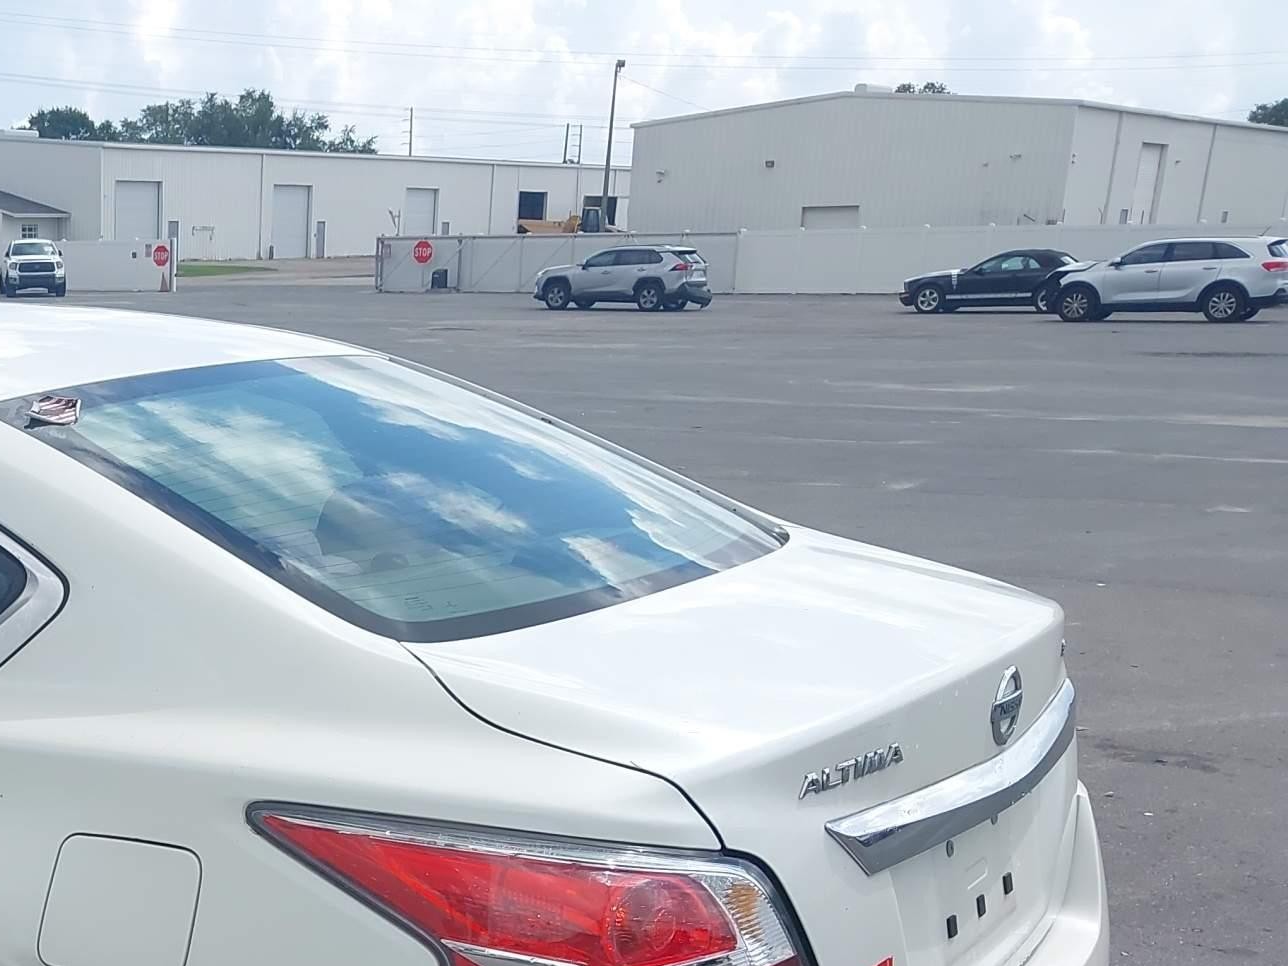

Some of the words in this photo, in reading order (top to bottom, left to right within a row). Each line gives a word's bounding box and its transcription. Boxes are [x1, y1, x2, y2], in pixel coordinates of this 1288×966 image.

[153, 251, 169, 261] STOP
[414, 247, 432, 257] STOP
[798, 742, 904, 800] ALTIMA
